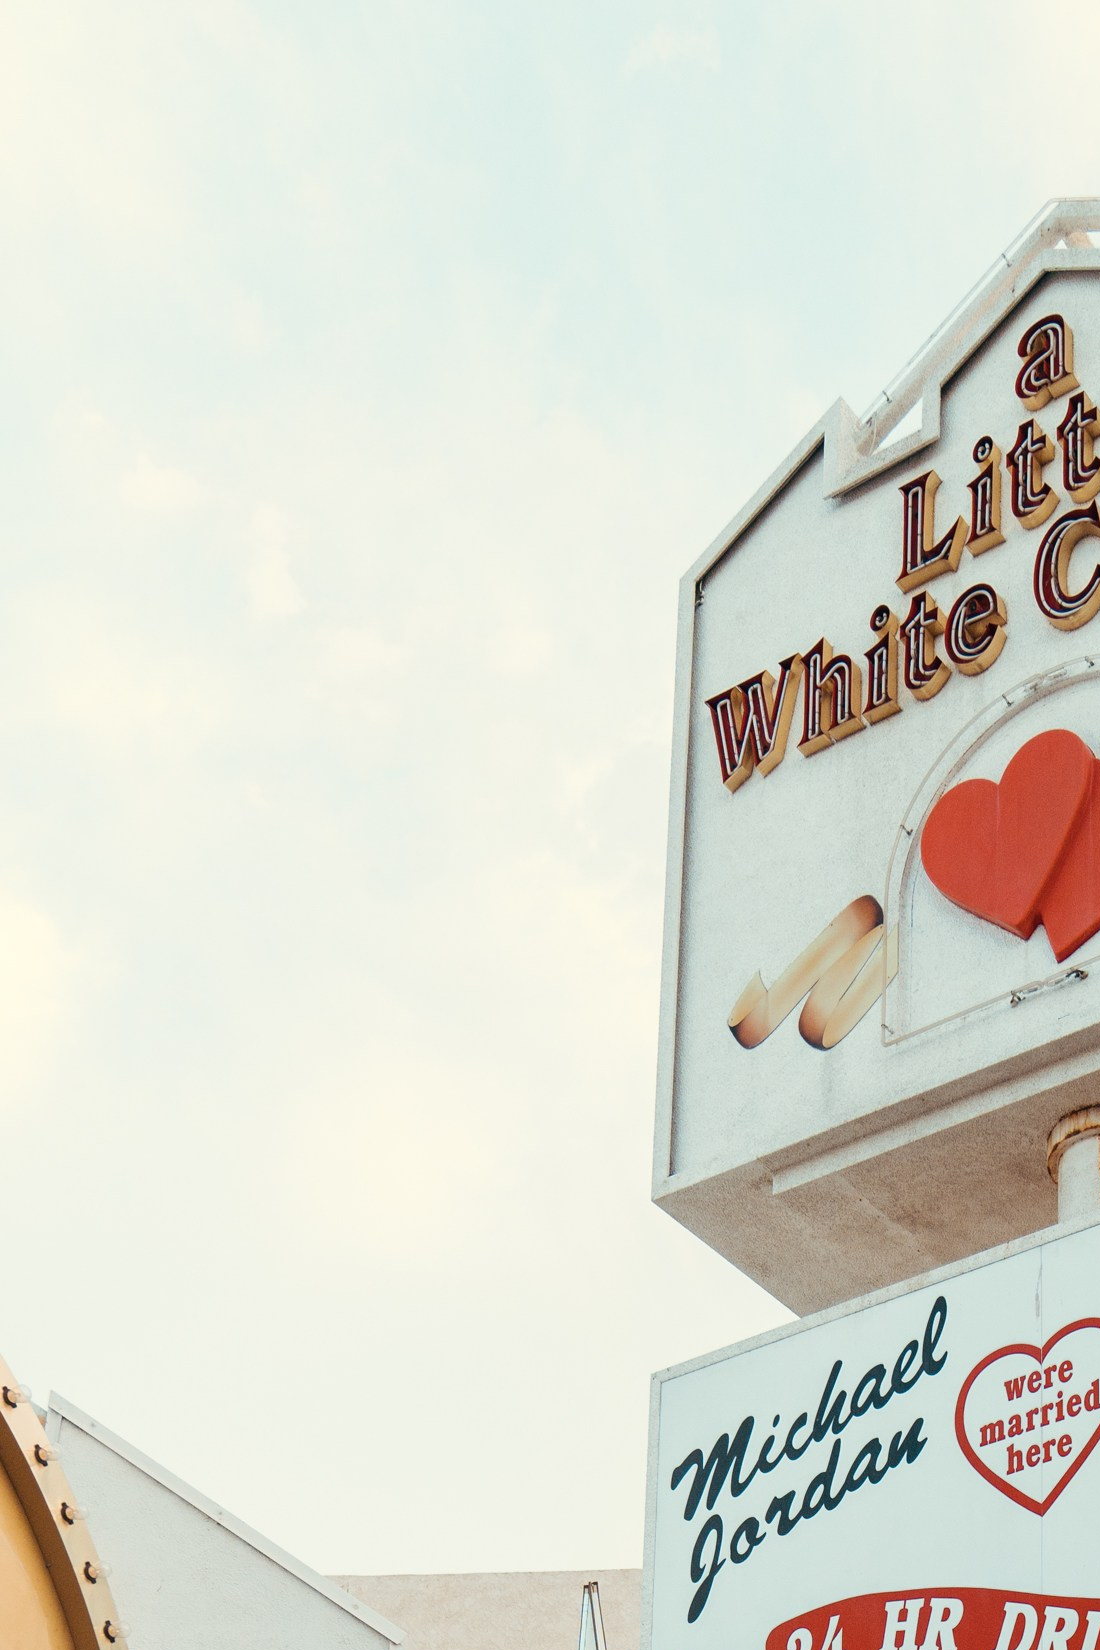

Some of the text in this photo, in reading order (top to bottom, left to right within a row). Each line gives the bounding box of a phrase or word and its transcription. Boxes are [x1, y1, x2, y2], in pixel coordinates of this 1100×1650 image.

[1014, 313, 1080, 410] a
[706, 582, 1007, 793] White
[671, 1296, 947, 1521] Michael
[1004, 1355, 1074, 1400] were
[688, 1418, 927, 1623] Jordan
[1006, 1435, 1073, 1475] here
